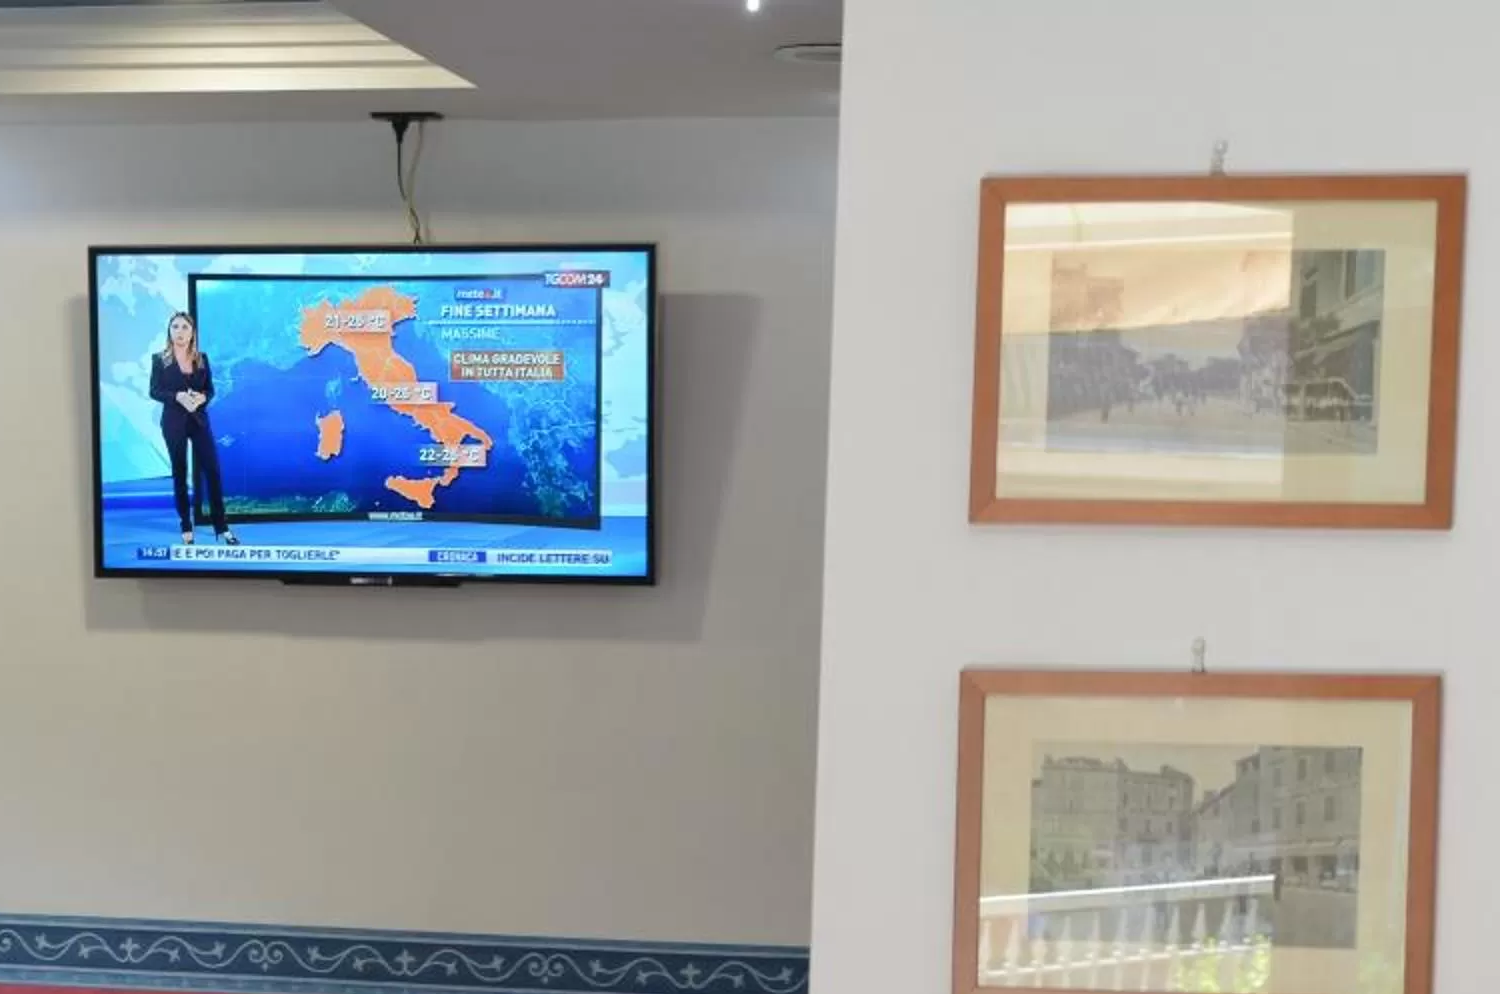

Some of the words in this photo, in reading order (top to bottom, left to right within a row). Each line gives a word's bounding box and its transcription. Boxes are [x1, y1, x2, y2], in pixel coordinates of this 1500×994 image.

[440, 303, 473, 317] FINE
[476, 303, 556, 317] SETTIMANA
[440, 327, 501, 340] MASSIME
[453, 353, 489, 365] CLIMA
[491, 353, 561, 365] GRADEVOLE
[461, 367, 474, 377] IN
[477, 367, 514, 377] TUTTA
[515, 367, 553, 377] ITALIA
[218, 548, 246, 560] PAGA
[249, 549, 271, 560] PER
[497, 552, 536, 564] INCIDE
[539, 552, 588, 564] LETTERE
